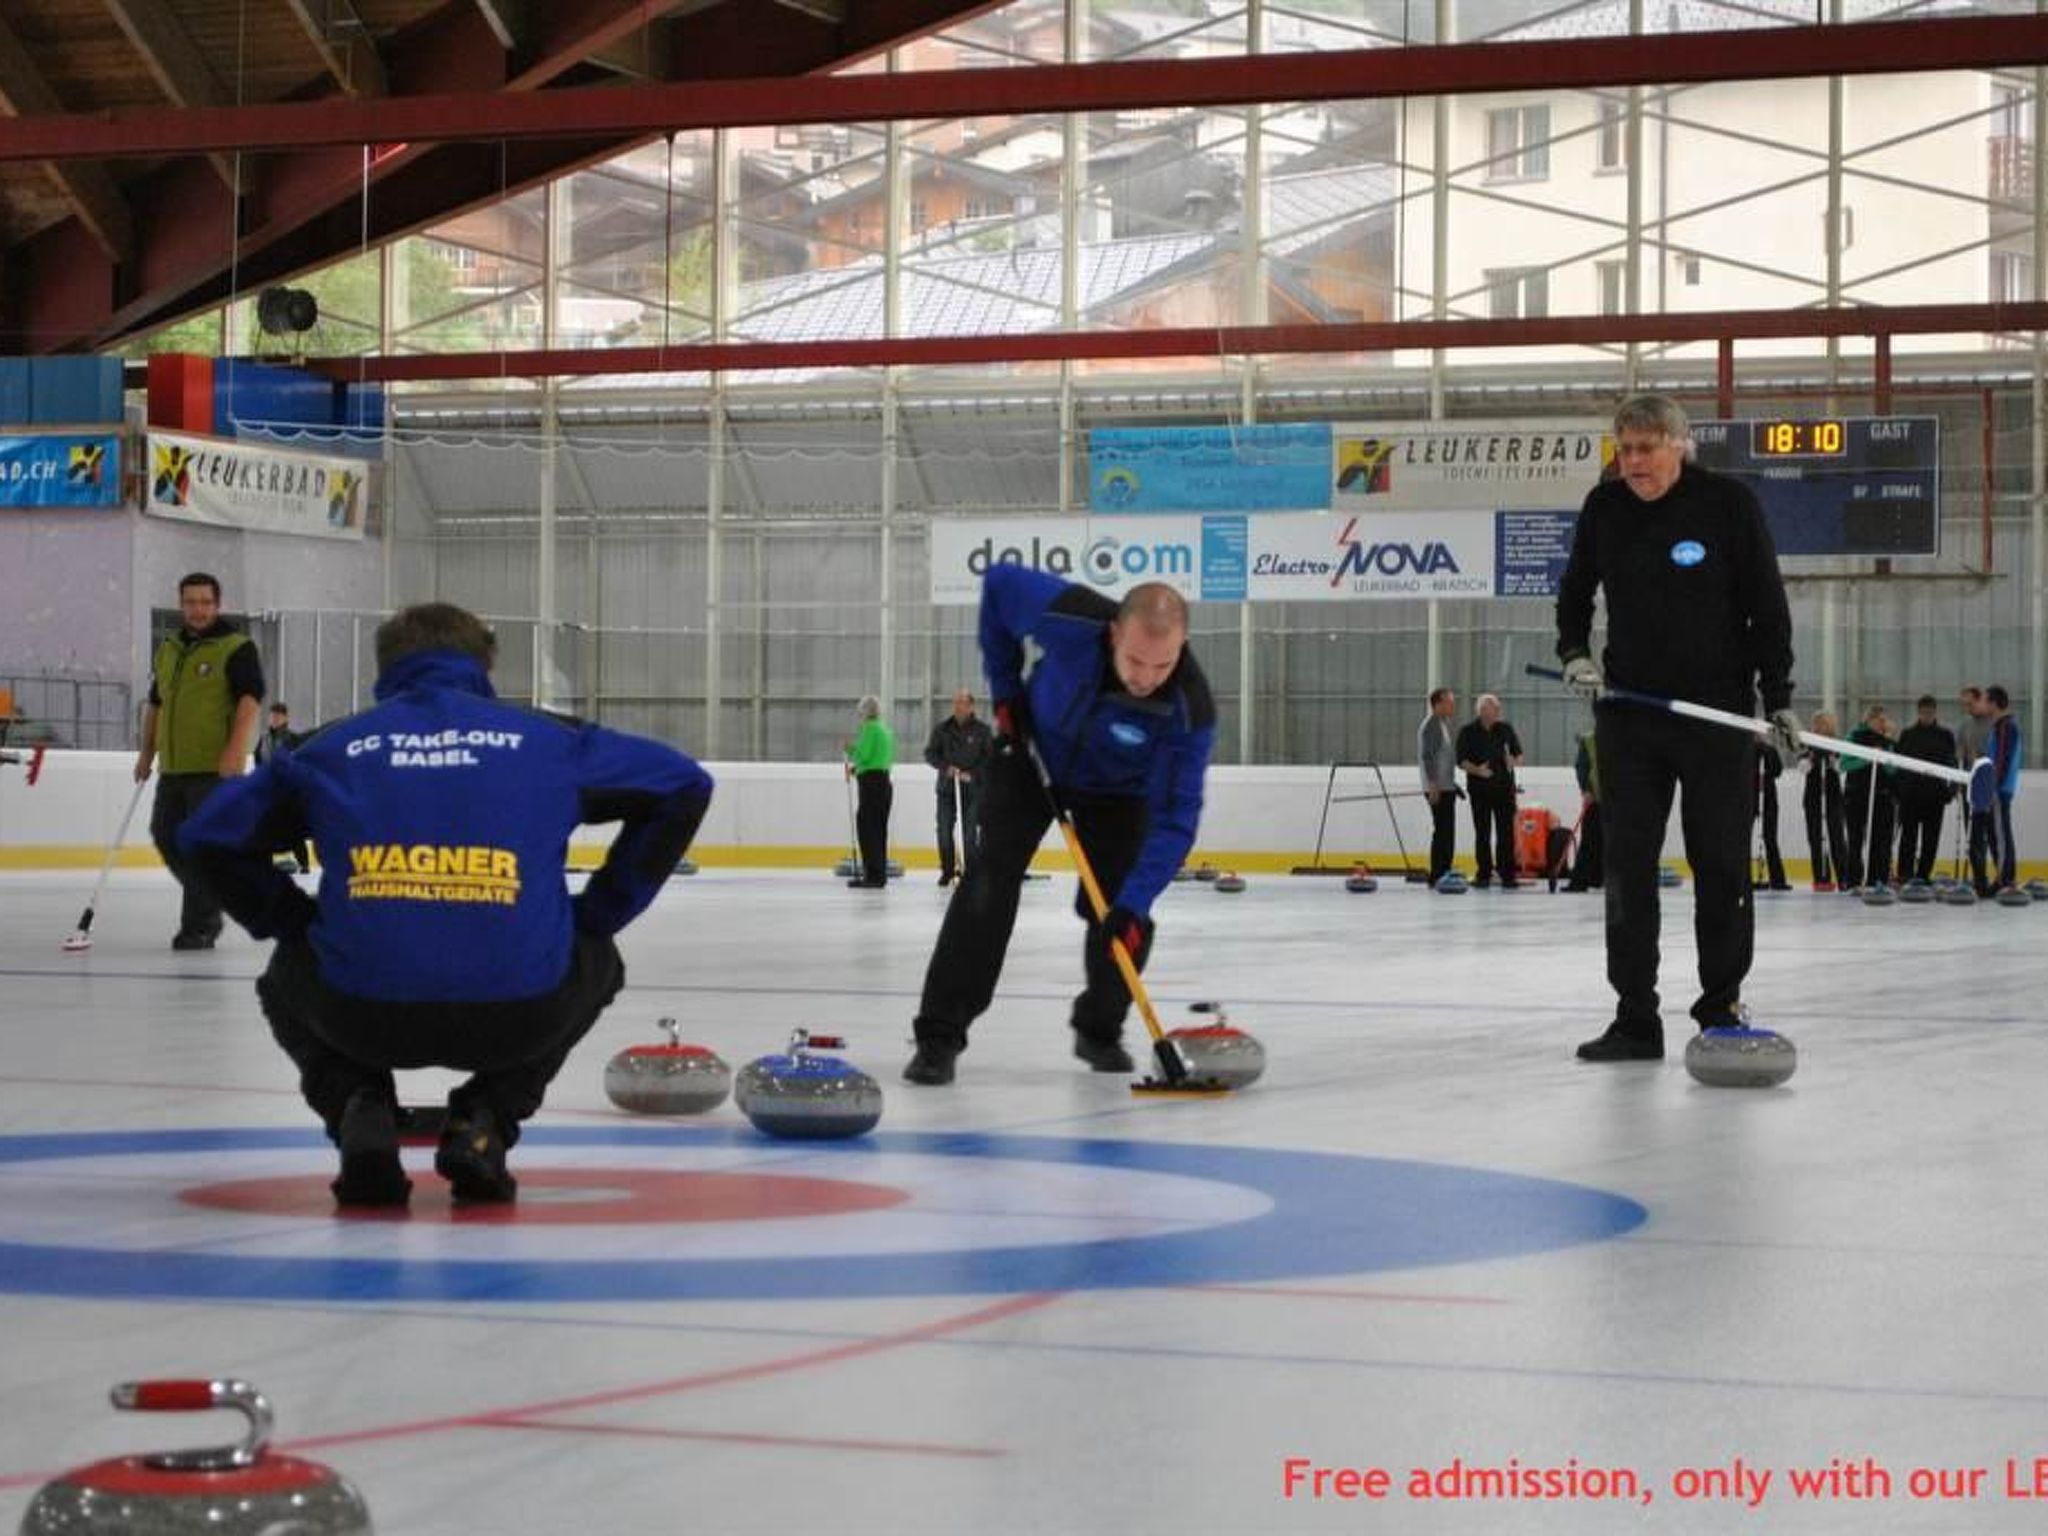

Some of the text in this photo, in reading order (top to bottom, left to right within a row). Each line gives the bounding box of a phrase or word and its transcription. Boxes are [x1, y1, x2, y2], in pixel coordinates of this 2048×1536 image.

[1767, 423, 1840, 452] 18:10
[1870, 423, 1911, 440] GAST
[1406, 437, 1592, 463] LEUKERBAD
[198, 453, 326, 498] LEUKERBAD
[1253, 554, 1329, 576] Electro
[1337, 541, 1460, 577] NOVA
[346, 729, 523, 756] CC TAKE-OUT
[391, 750, 479, 767] BASEL
[350, 844, 518, 878] WAGNER
